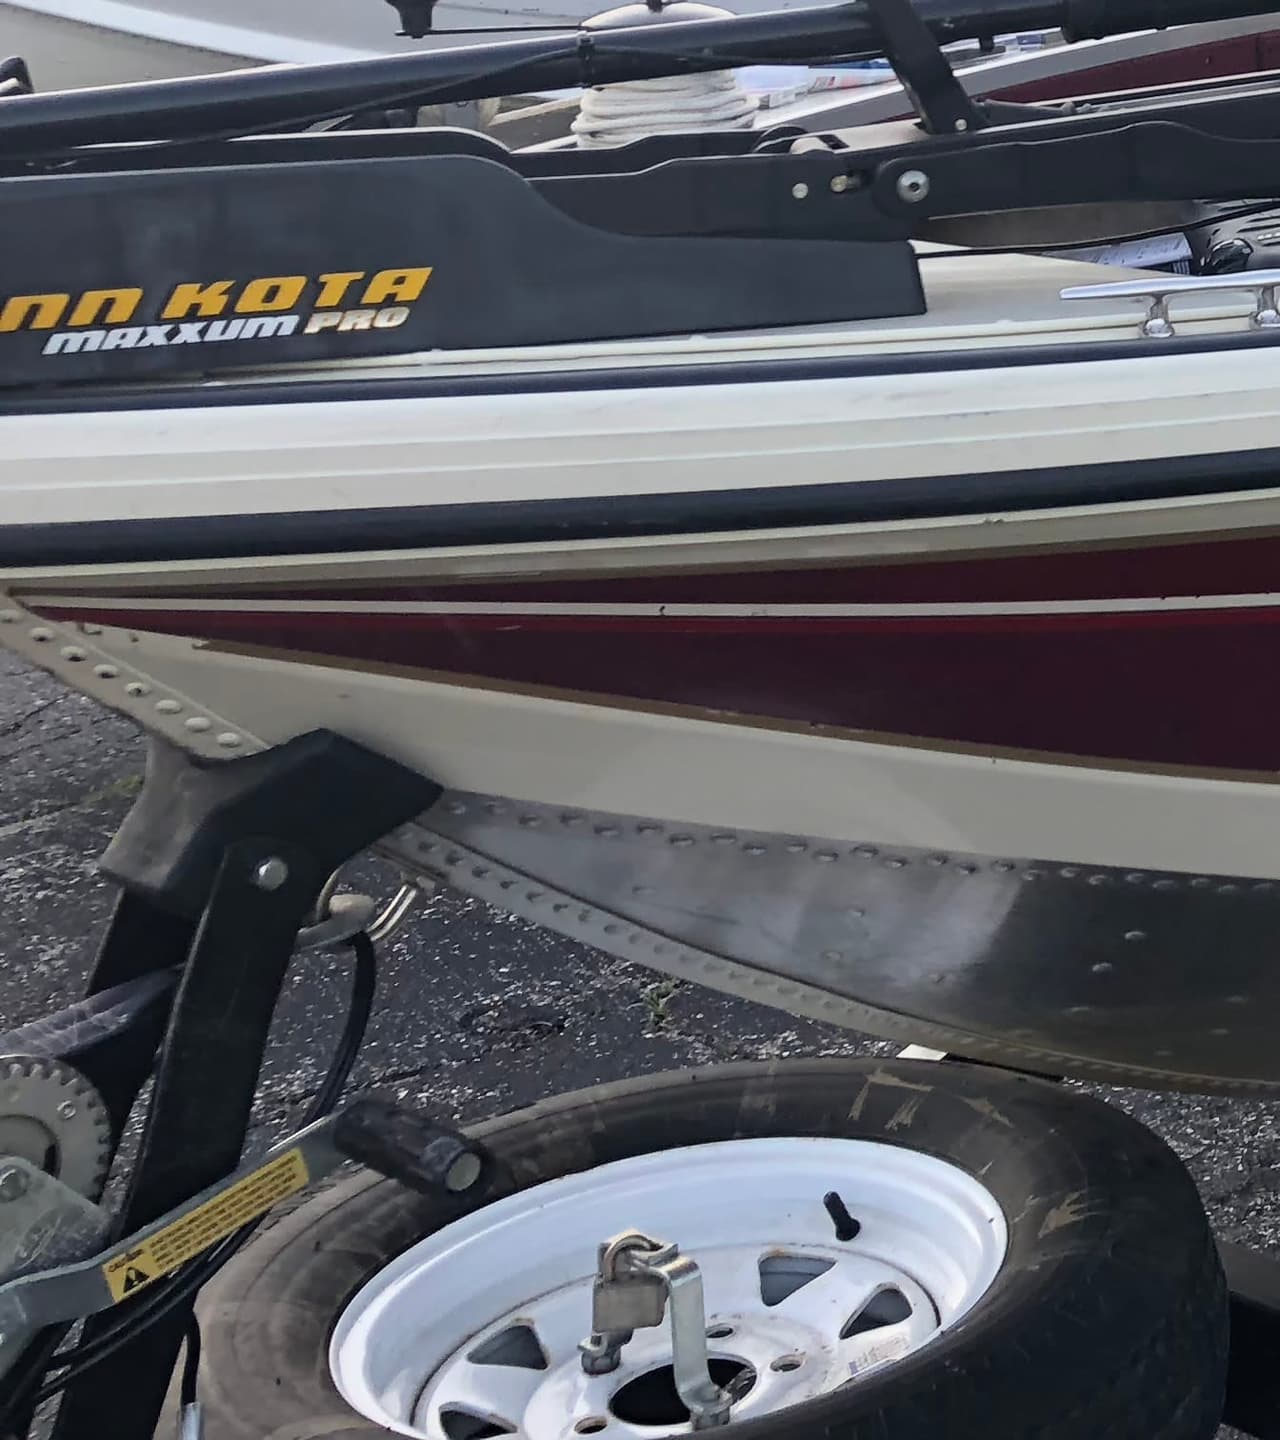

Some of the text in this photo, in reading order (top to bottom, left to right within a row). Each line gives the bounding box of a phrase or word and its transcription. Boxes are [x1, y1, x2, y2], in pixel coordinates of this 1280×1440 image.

[161, 267, 432, 319] KOTA
[42, 307, 411, 355] MAXXUM PRO
